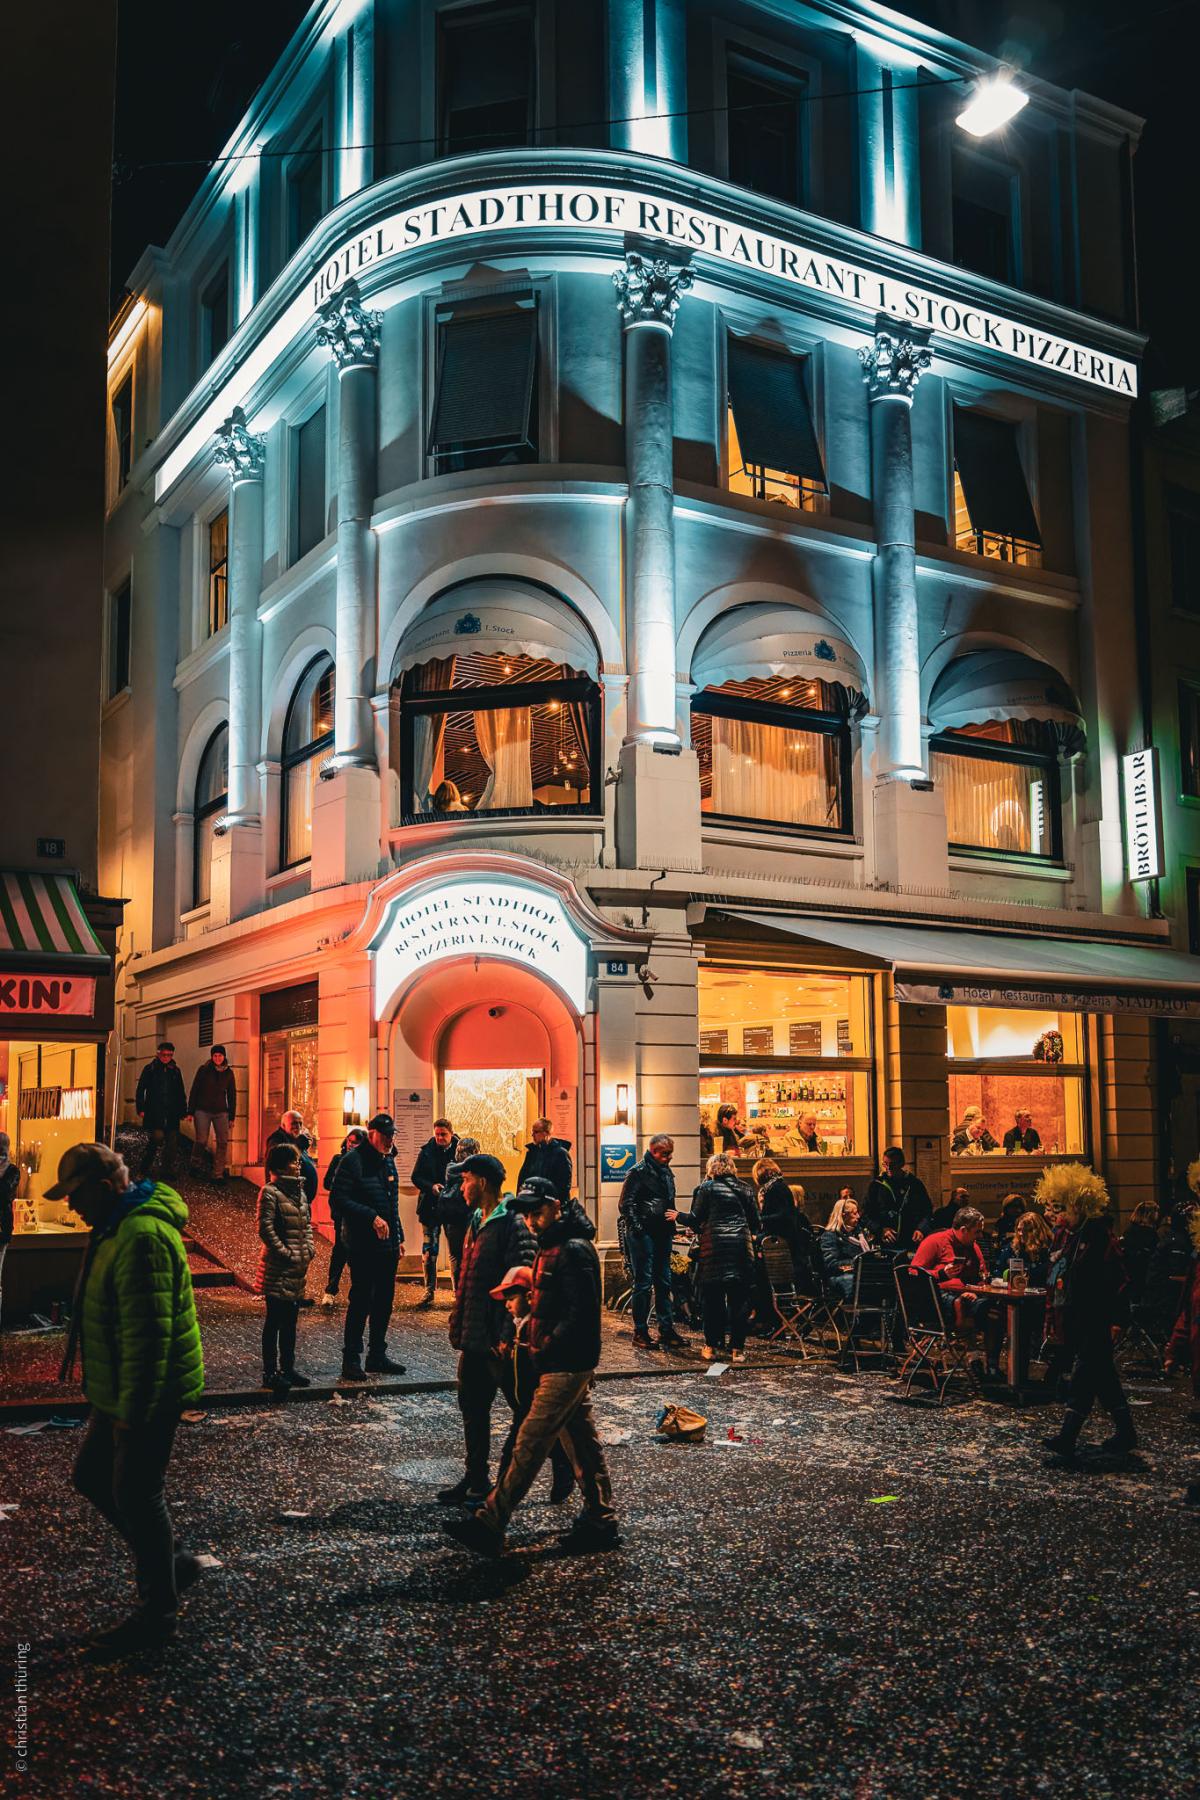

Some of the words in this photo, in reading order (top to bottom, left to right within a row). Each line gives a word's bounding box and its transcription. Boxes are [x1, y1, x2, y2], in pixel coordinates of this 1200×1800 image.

[313, 229, 394, 306] HOTEL
[404, 193, 624, 244] STADTHOF
[638, 201, 866, 298] RESTAURANT
[878, 282, 897, 312] 1.
[905, 291, 1003, 347] STOCK
[1012, 328, 1133, 392] PIZZERIA
[1133, 754, 1151, 876] BRÖTLIBAR
[400, 900, 455, 929] HOTEL
[463, 896, 560, 925] STADTHOF
[395, 915, 491, 955] RESTAURANT
[511, 921, 563, 952] STOCK
[415, 934, 475, 961] PIZZERIA
[493, 936, 539, 959] STOCK
[611, 963, 623, 972] 84
[963, 986, 992, 999] Hotel
[1000, 989, 1055, 1003] Restaurant
